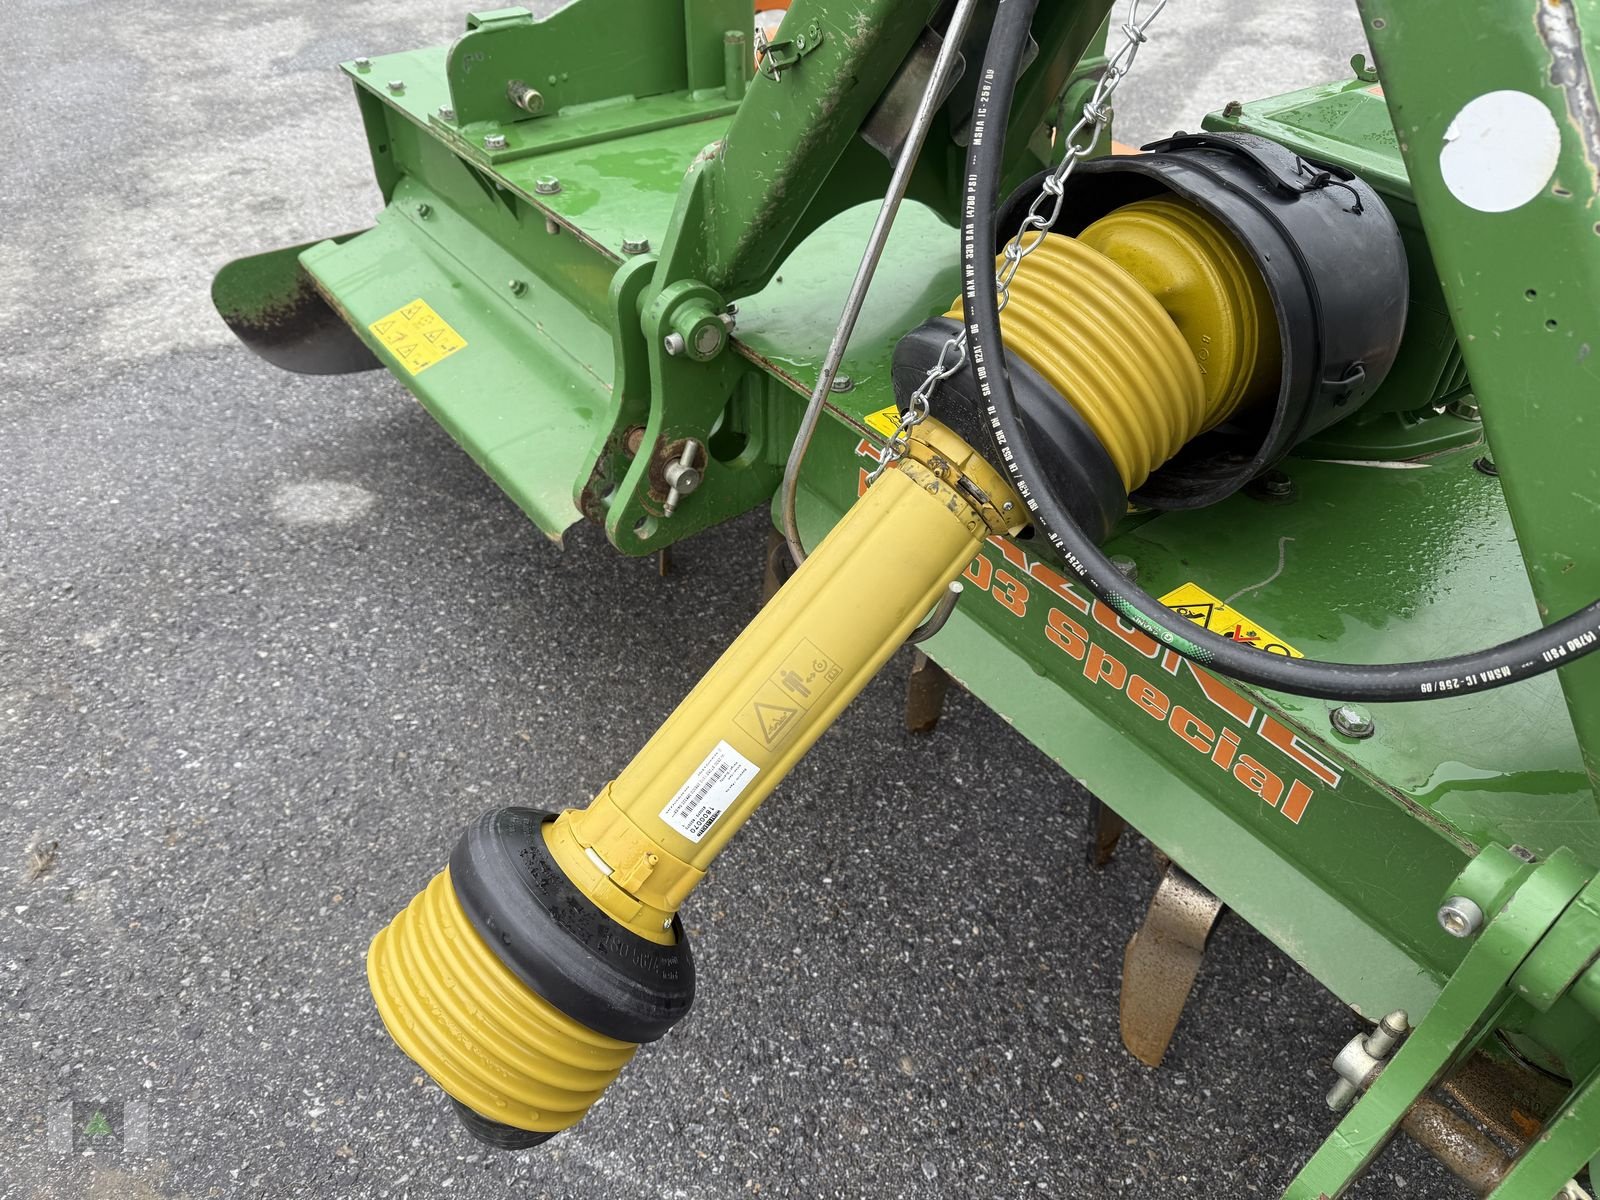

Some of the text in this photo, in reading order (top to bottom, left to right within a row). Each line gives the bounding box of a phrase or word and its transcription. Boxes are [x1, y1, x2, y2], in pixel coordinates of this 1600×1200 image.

[972, 120, 985, 146] MSHA
[968, 174, 978, 193] PSI)
[966, 223, 974, 241] BAR
[966, 264, 974, 280] WP
[966, 280, 976, 298] MAX
[973, 345, 984, 364] R2AT
[977, 366, 987, 380] 100
[980, 382, 991, 397] SAE
[987, 406, 997, 416] 10
[990, 417, 1001, 428] DN
[1008, 462, 1019, 473] EN
[1026, 498, 1039, 512] ISO
[1542, 644, 1567, 662] PSI)
[1480, 665, 1512, 683] MSHA
[962, 553, 1314, 825] 03 Special
